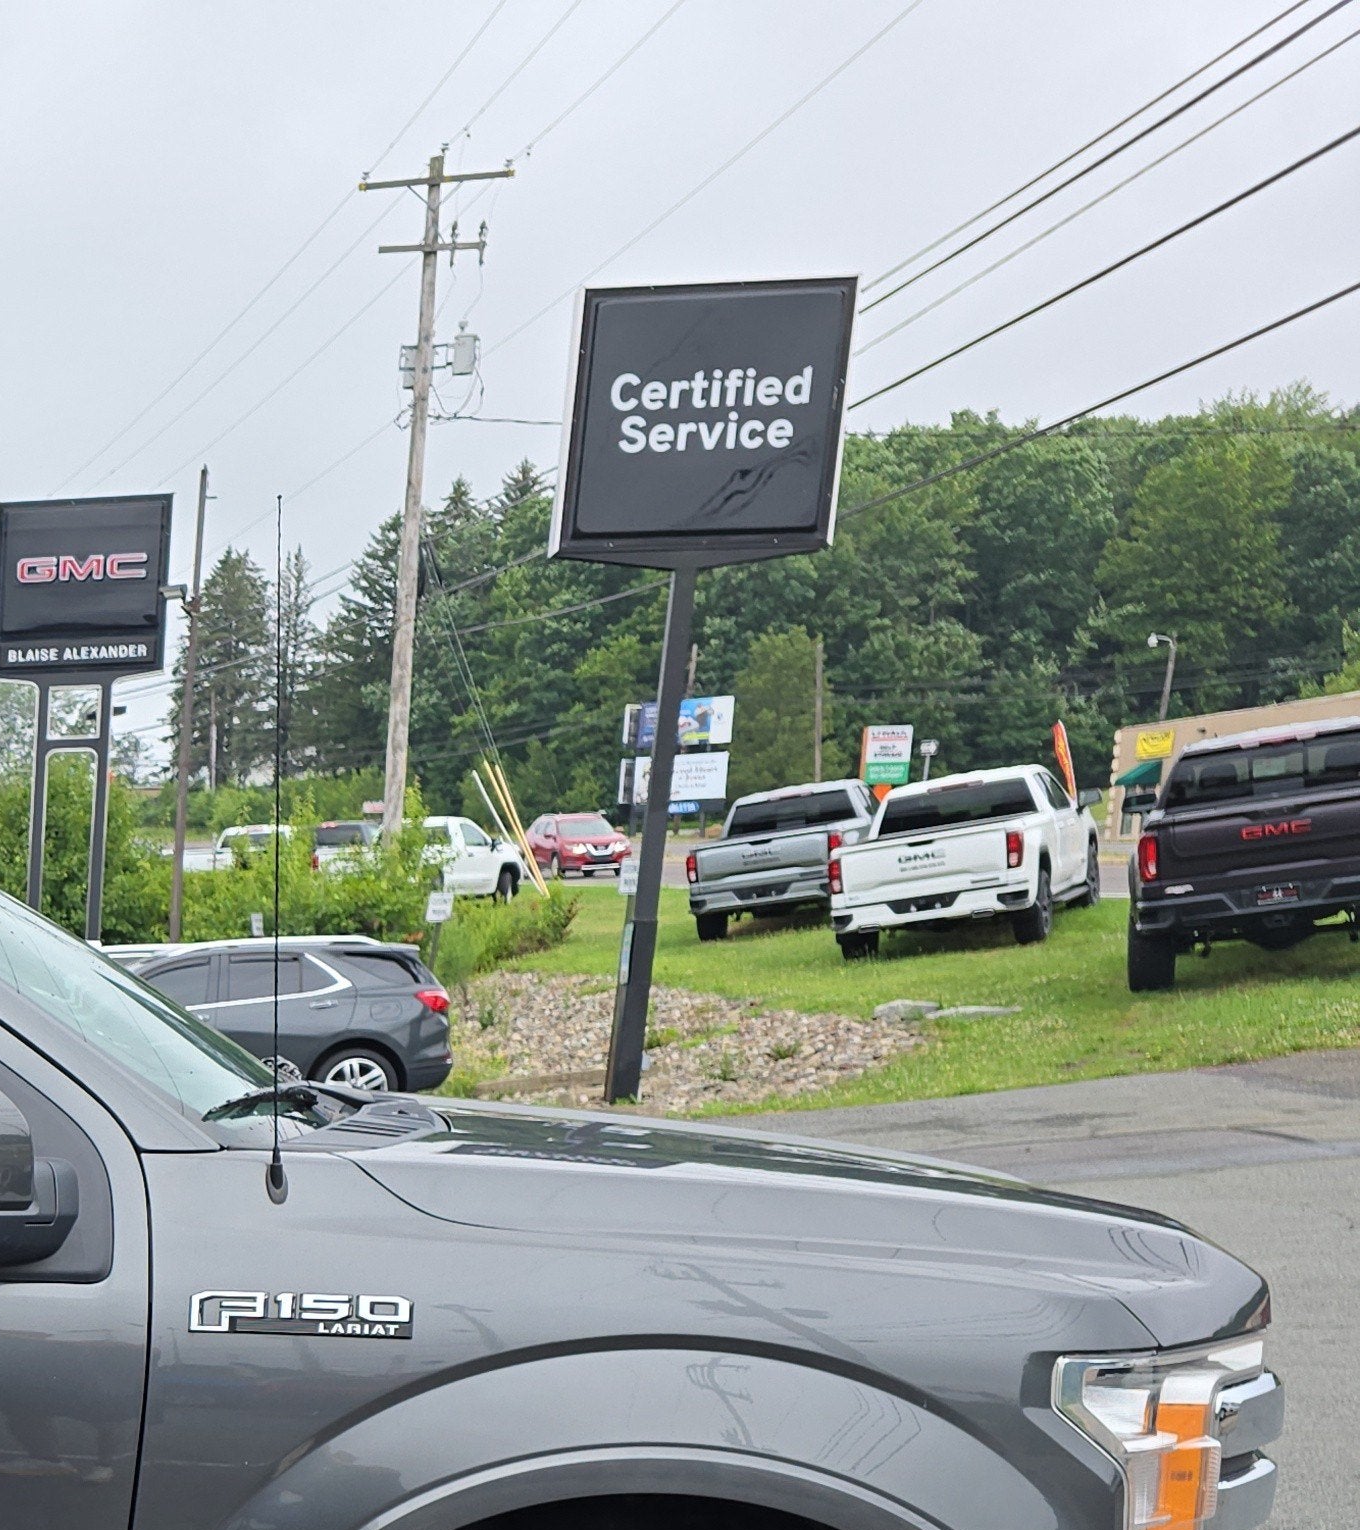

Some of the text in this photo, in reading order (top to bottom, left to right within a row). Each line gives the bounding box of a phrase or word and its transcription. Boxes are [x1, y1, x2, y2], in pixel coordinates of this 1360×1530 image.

[610, 365, 813, 412] Certified
[618, 411, 793, 454] Service
[17, 552, 148, 583] GMC
[7, 643, 148, 664] BLAISE ALEXANDER
[1241, 818, 1312, 841] GMC
[897, 848, 946, 865] GMC
[317, 1321, 399, 1336] LARIAT
